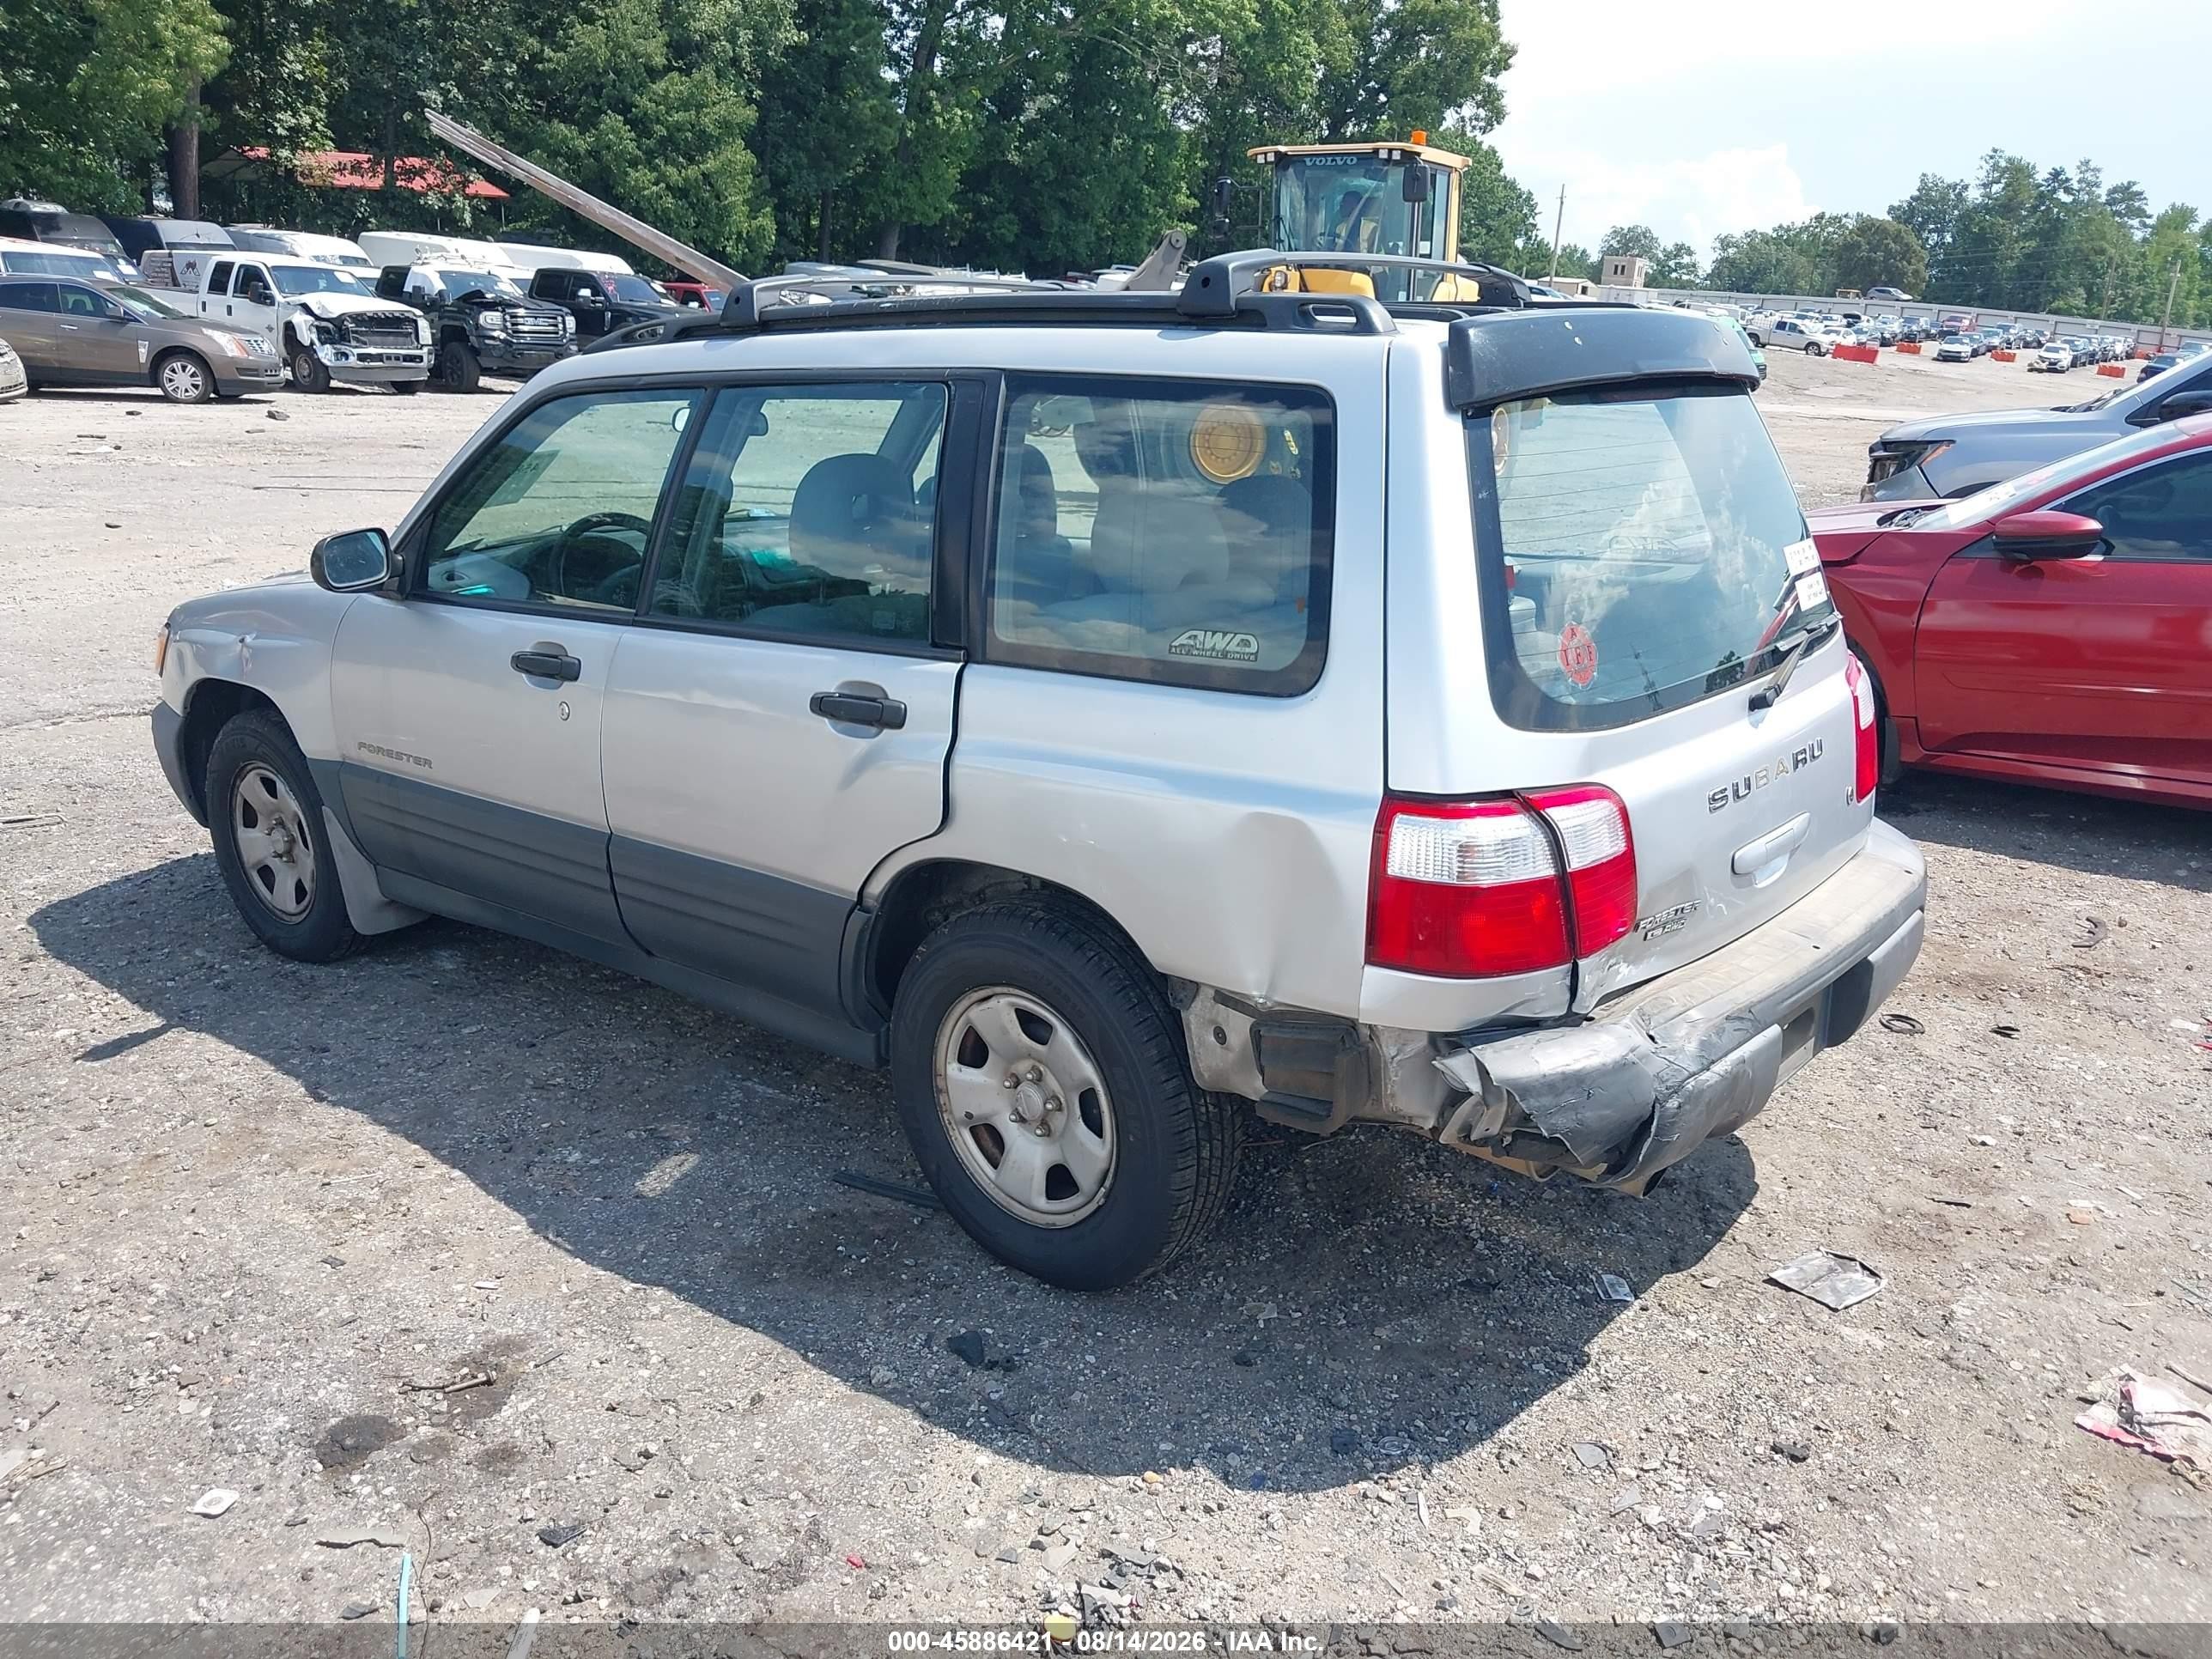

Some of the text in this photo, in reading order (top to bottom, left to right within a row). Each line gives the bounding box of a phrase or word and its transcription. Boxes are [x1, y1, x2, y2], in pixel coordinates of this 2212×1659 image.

[1304, 156, 1358, 167] VOLVO
[1170, 629, 1259, 653] AWD
[1227, 653, 1256, 661] DRIVE
[356, 740, 434, 769] FORESTER
[1707, 738, 1823, 814] SUBARU
[1633, 898, 1702, 933] FORESTER
